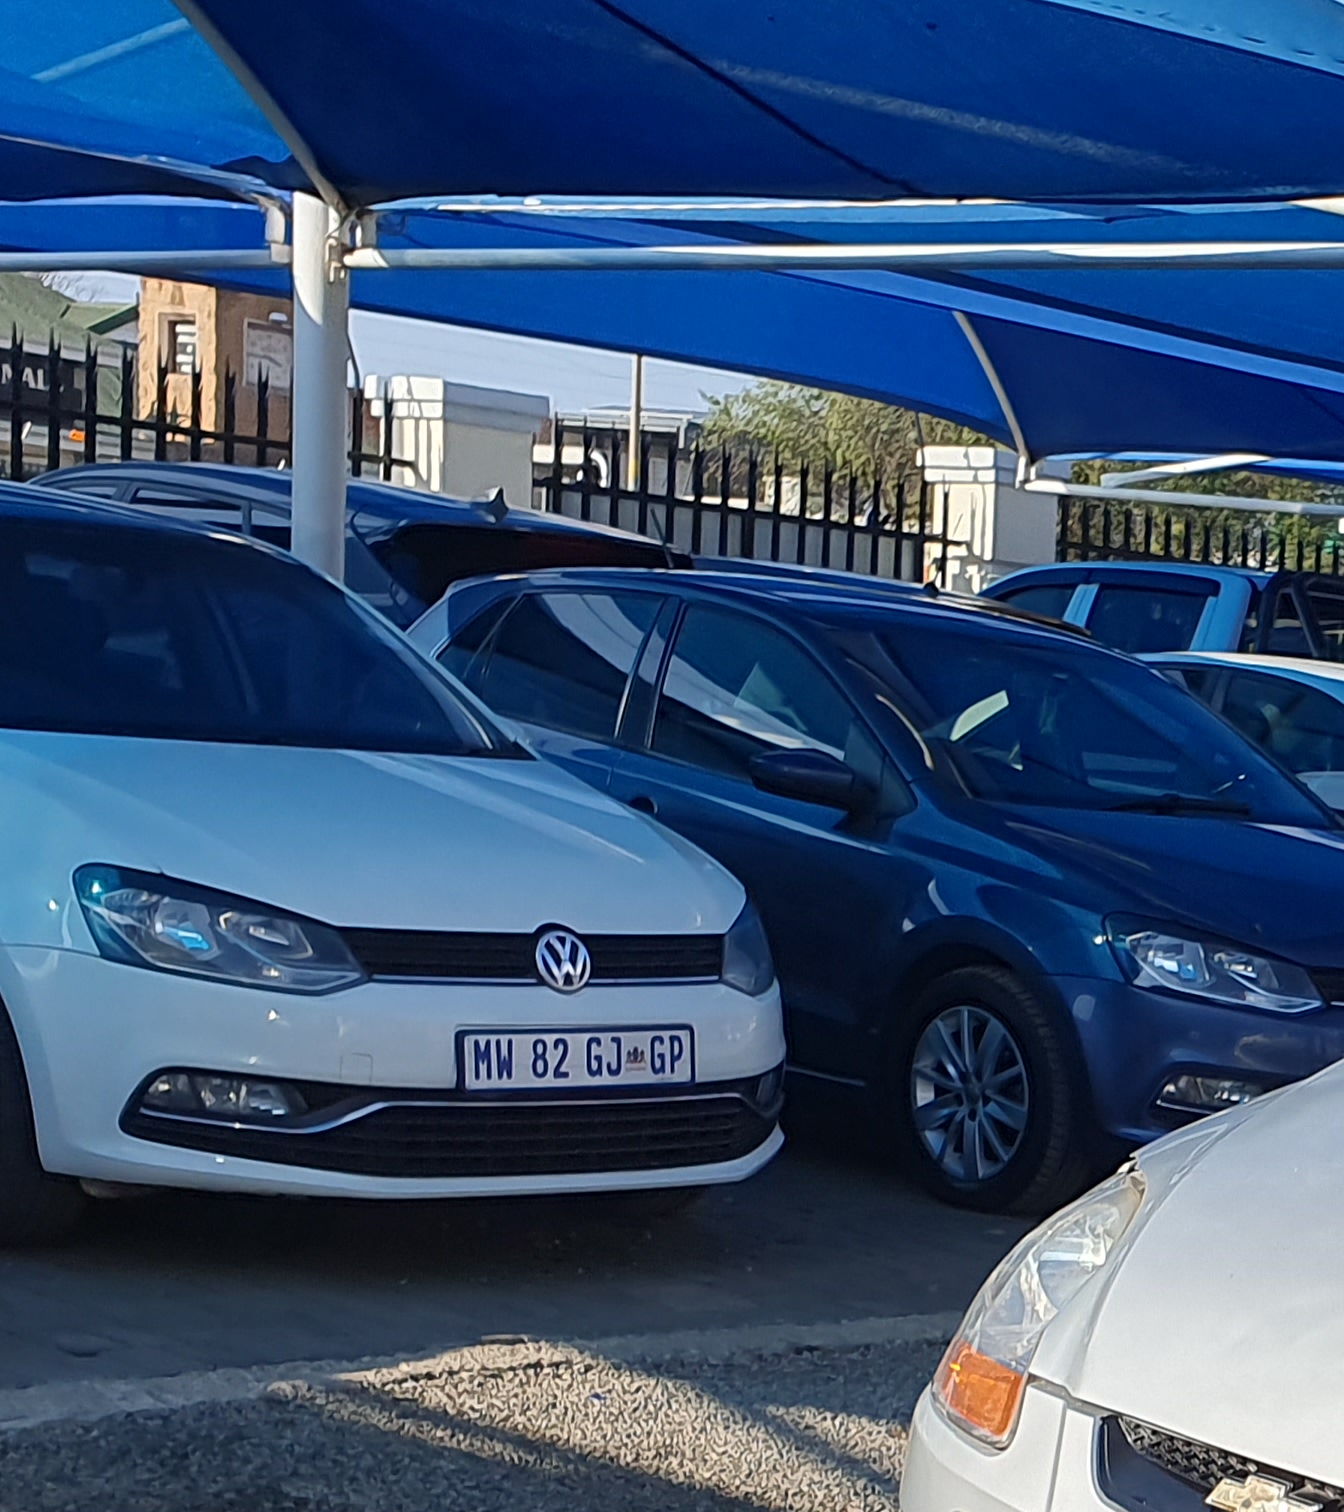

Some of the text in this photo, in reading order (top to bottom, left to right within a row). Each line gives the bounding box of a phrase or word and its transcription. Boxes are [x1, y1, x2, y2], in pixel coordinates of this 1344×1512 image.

[474, 1034, 684, 1081] MW 82 GJ GP
